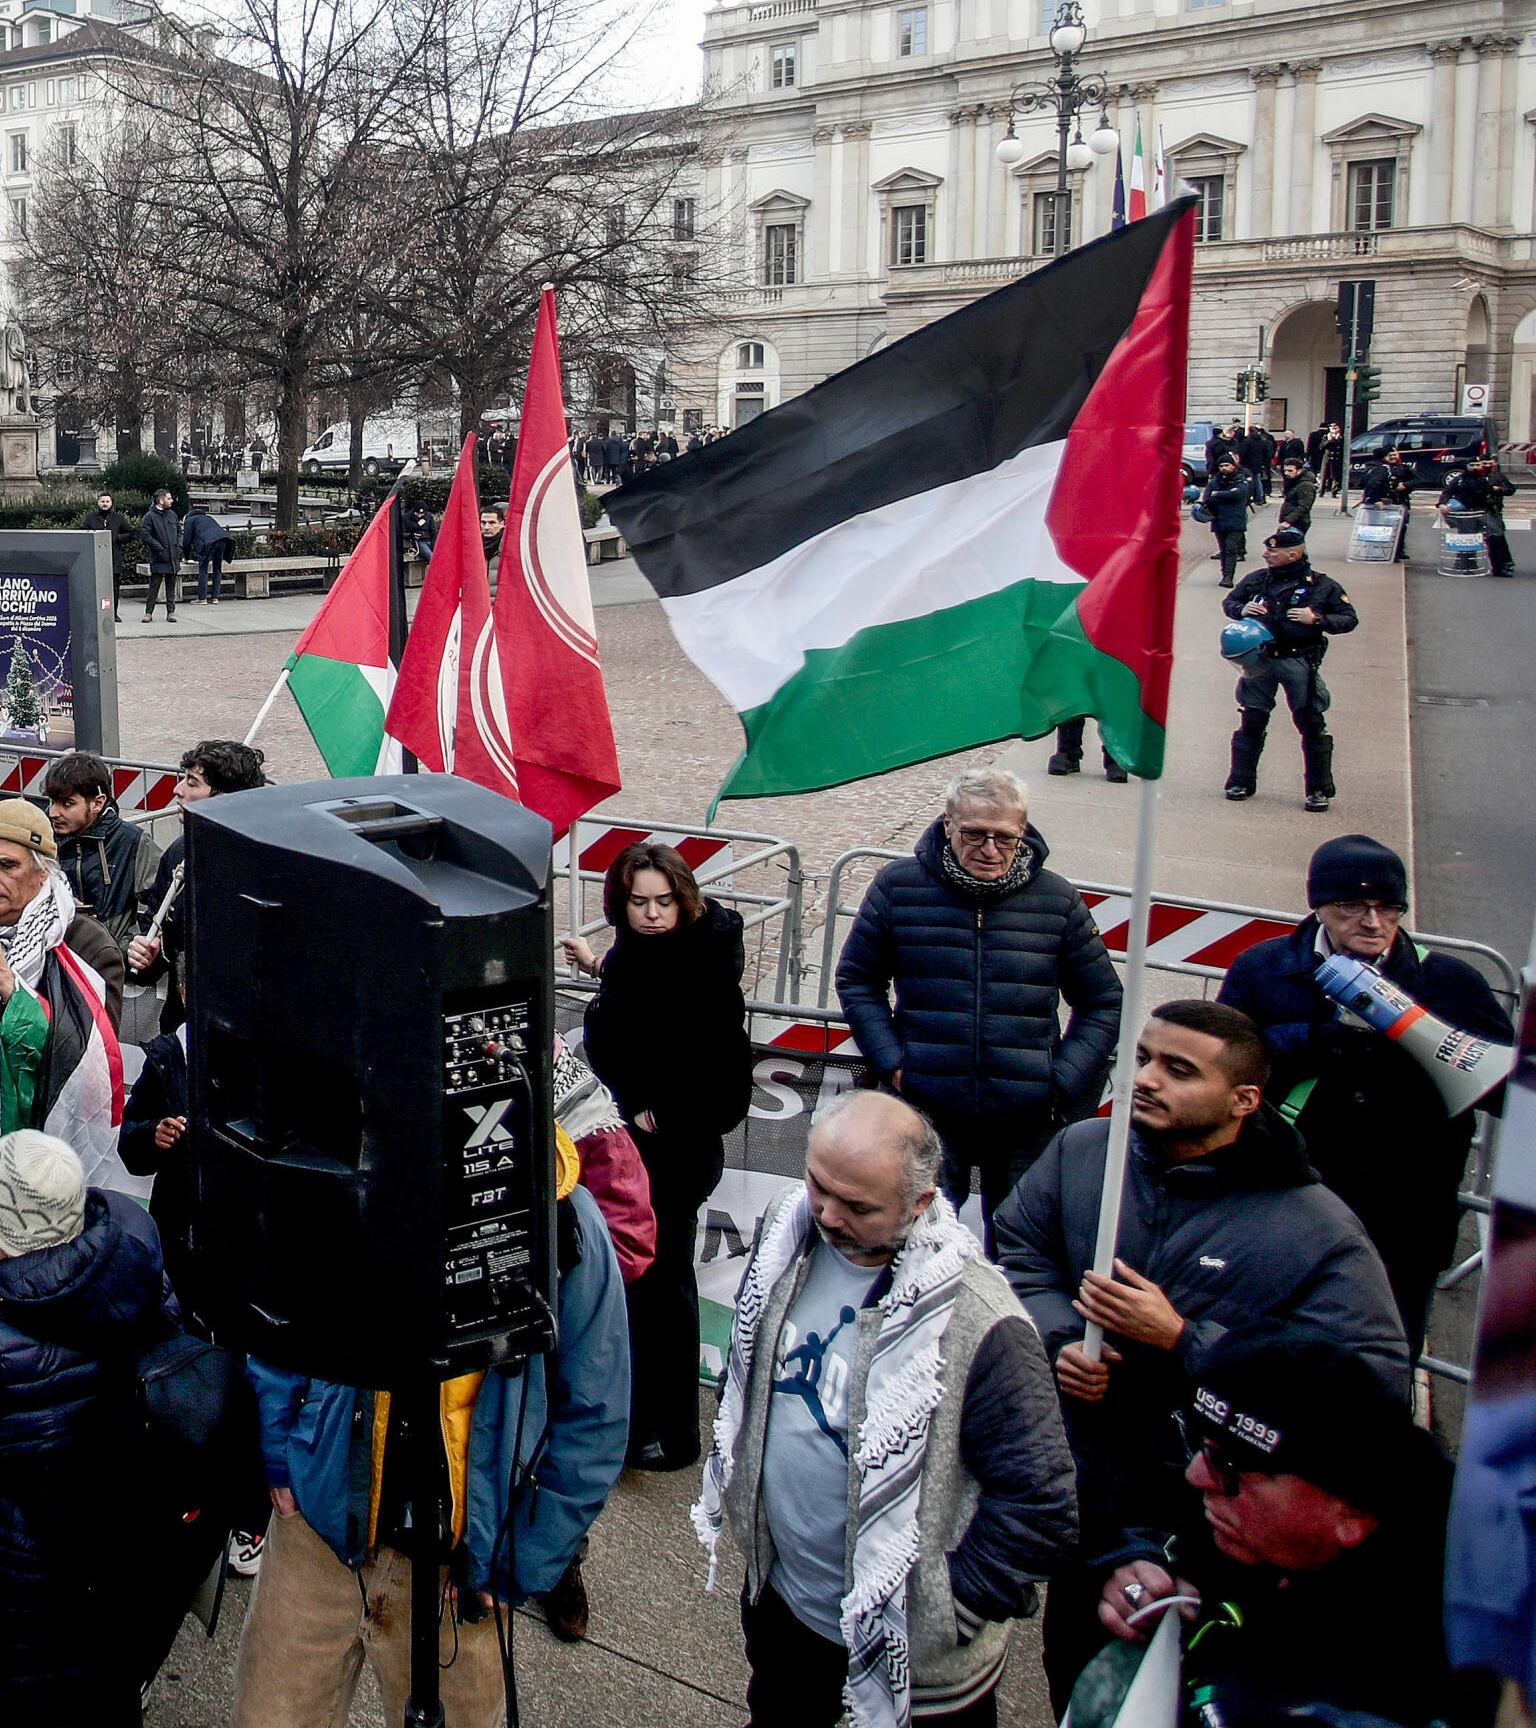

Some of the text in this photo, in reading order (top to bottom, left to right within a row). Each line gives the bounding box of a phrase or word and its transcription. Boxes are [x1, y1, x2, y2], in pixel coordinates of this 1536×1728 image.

[463, 1140, 514, 1158] LITE
[463, 1156, 514, 1174] 115 A
[471, 1187, 507, 1207] FBT
[1196, 1387, 1227, 1417] USC
[1234, 1413, 1279, 1445] 1999
